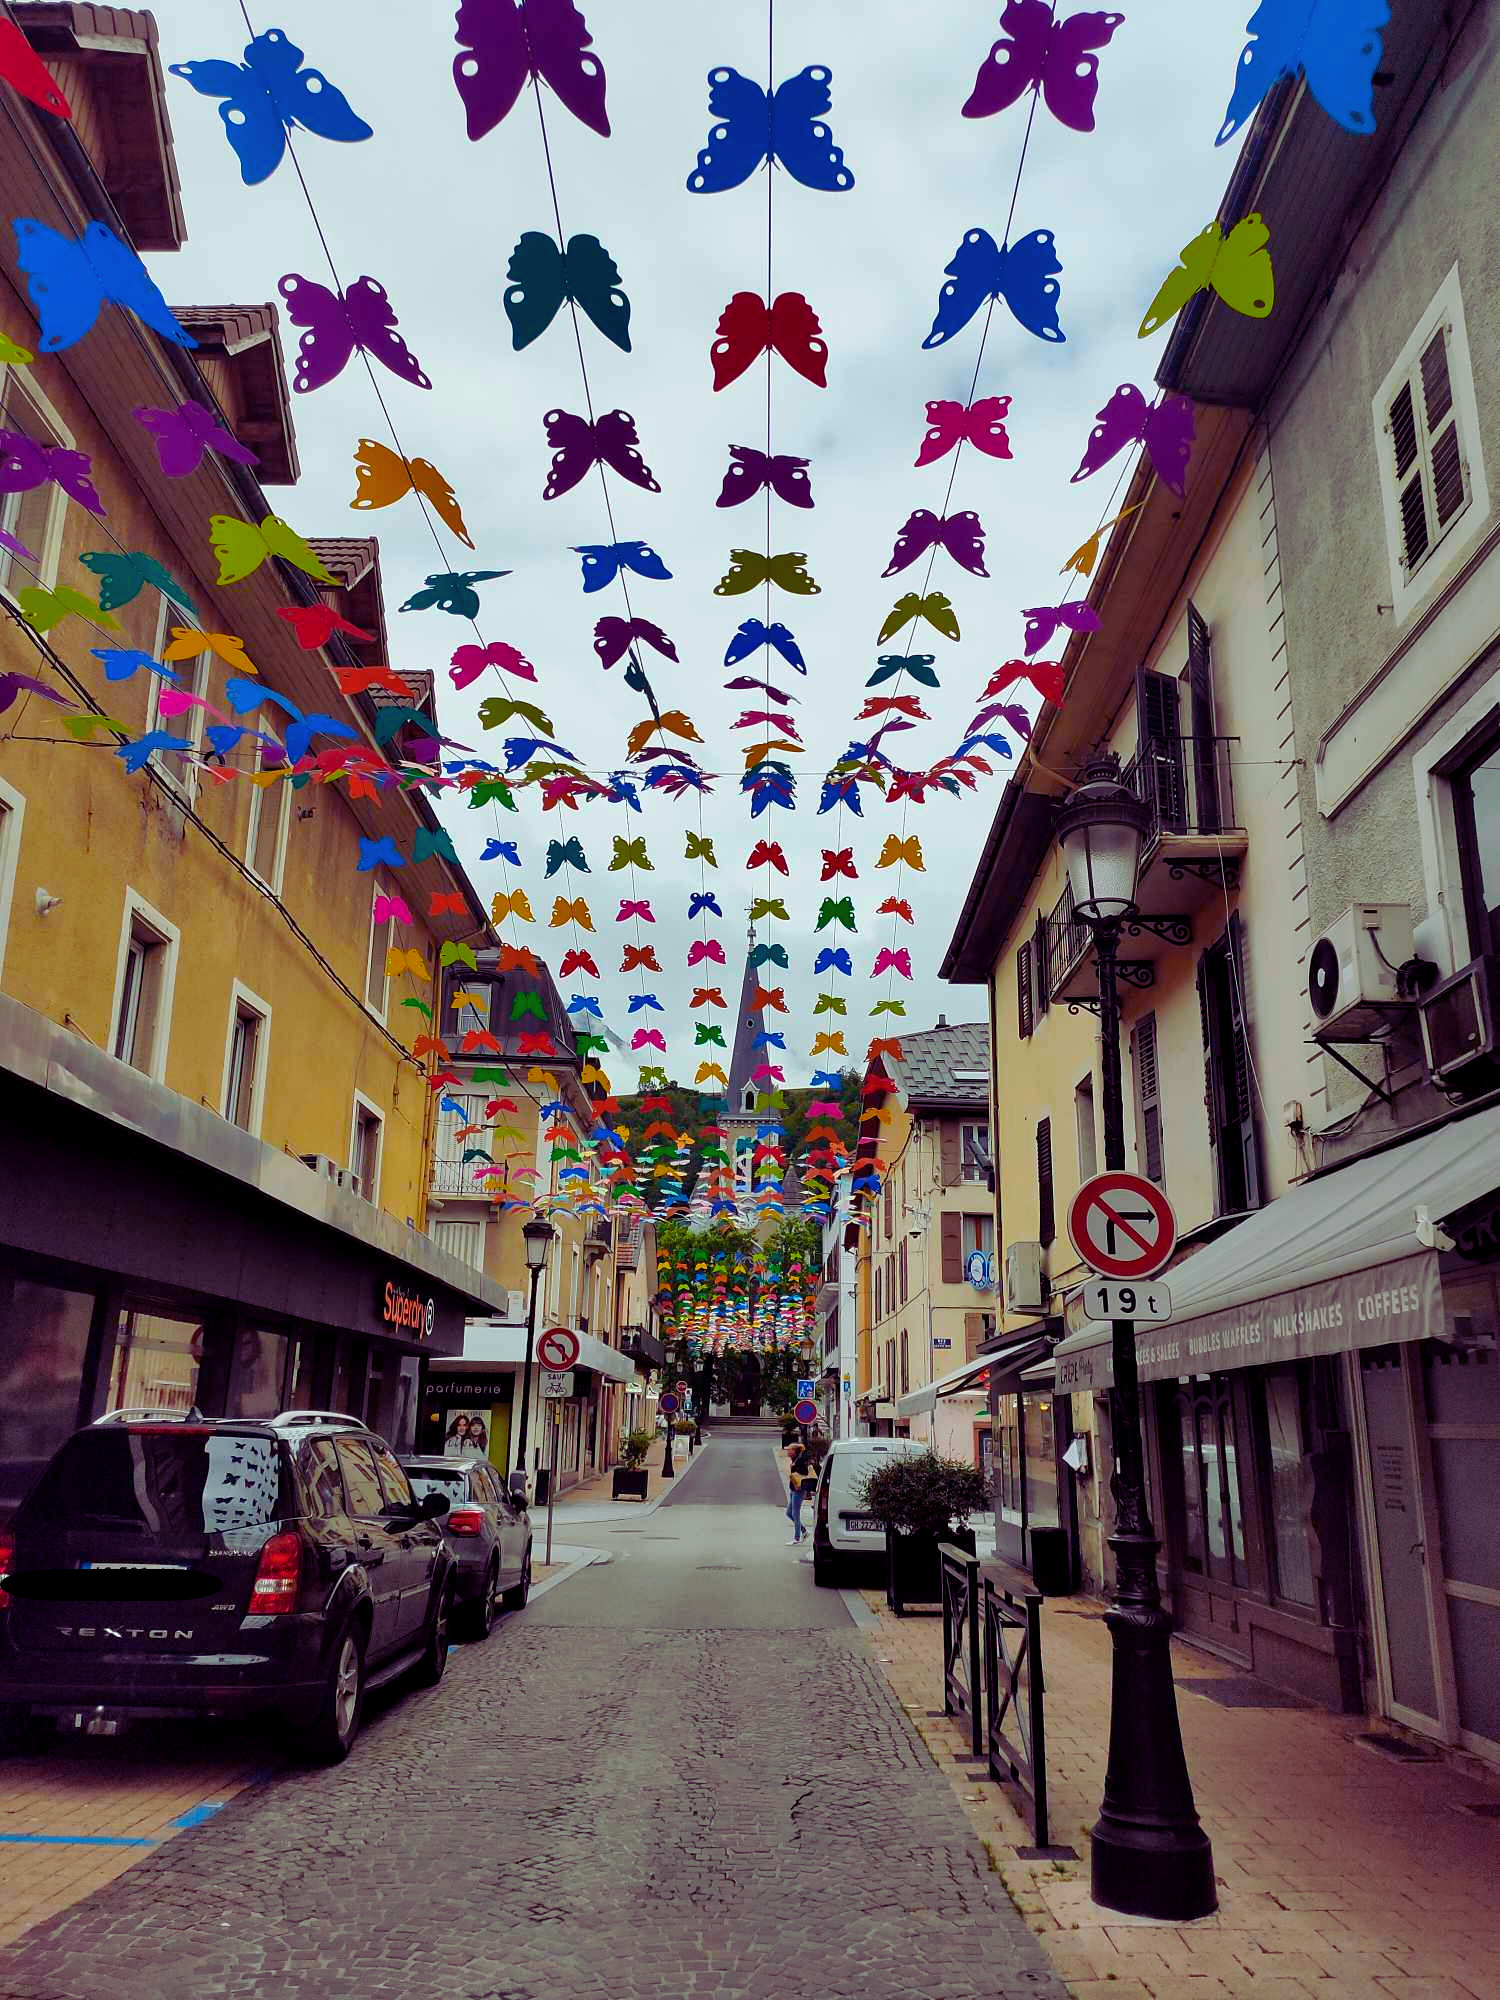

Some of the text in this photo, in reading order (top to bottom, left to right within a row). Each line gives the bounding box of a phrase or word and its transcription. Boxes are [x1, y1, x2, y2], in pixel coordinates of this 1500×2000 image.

[1097, 1287, 1158, 1313] 19 t
[1357, 1284, 1420, 1321] COFFEES
[1272, 1303, 1343, 1338] MILKSHAKES
[1189, 1322, 1261, 1356] BUBBLES WAFFLES
[426, 1382, 501, 1397] parfumerie
[547, 1373, 566, 1381] SAUF
[56, 1625, 194, 1639] REXTON
